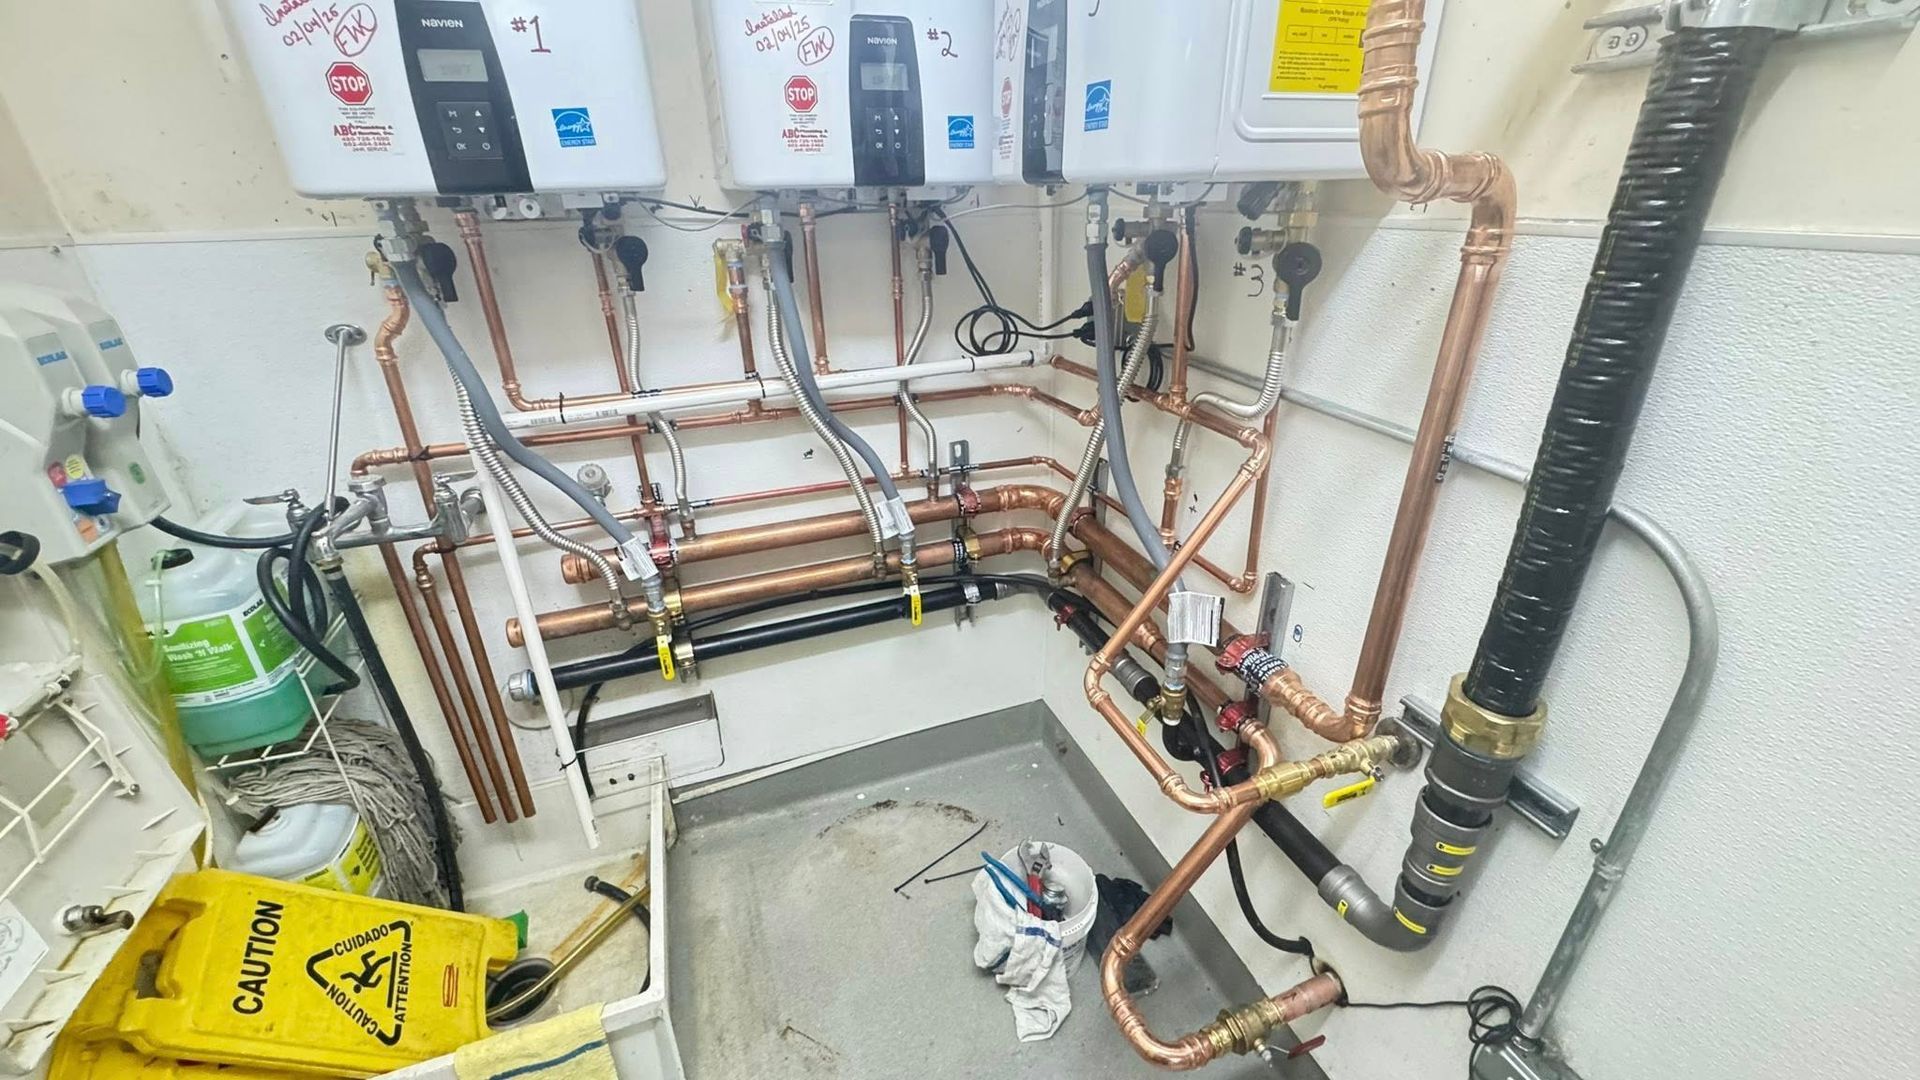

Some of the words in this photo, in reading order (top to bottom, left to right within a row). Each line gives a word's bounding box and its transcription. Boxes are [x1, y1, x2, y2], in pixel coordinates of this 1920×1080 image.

[510, 15, 552, 53] #1
[927, 28, 958, 58] #2
[331, 76, 367, 92] STOP
[788, 87, 814, 102] STOP
[333, 124, 356, 136] ABC
[1233, 262, 1265, 297] #3
[334, 924, 389, 956] CUIDADO
[232, 900, 284, 1015] CAUTION
[393, 942, 412, 1023] ATTENTION
[326, 983, 378, 1036] CAUTION
